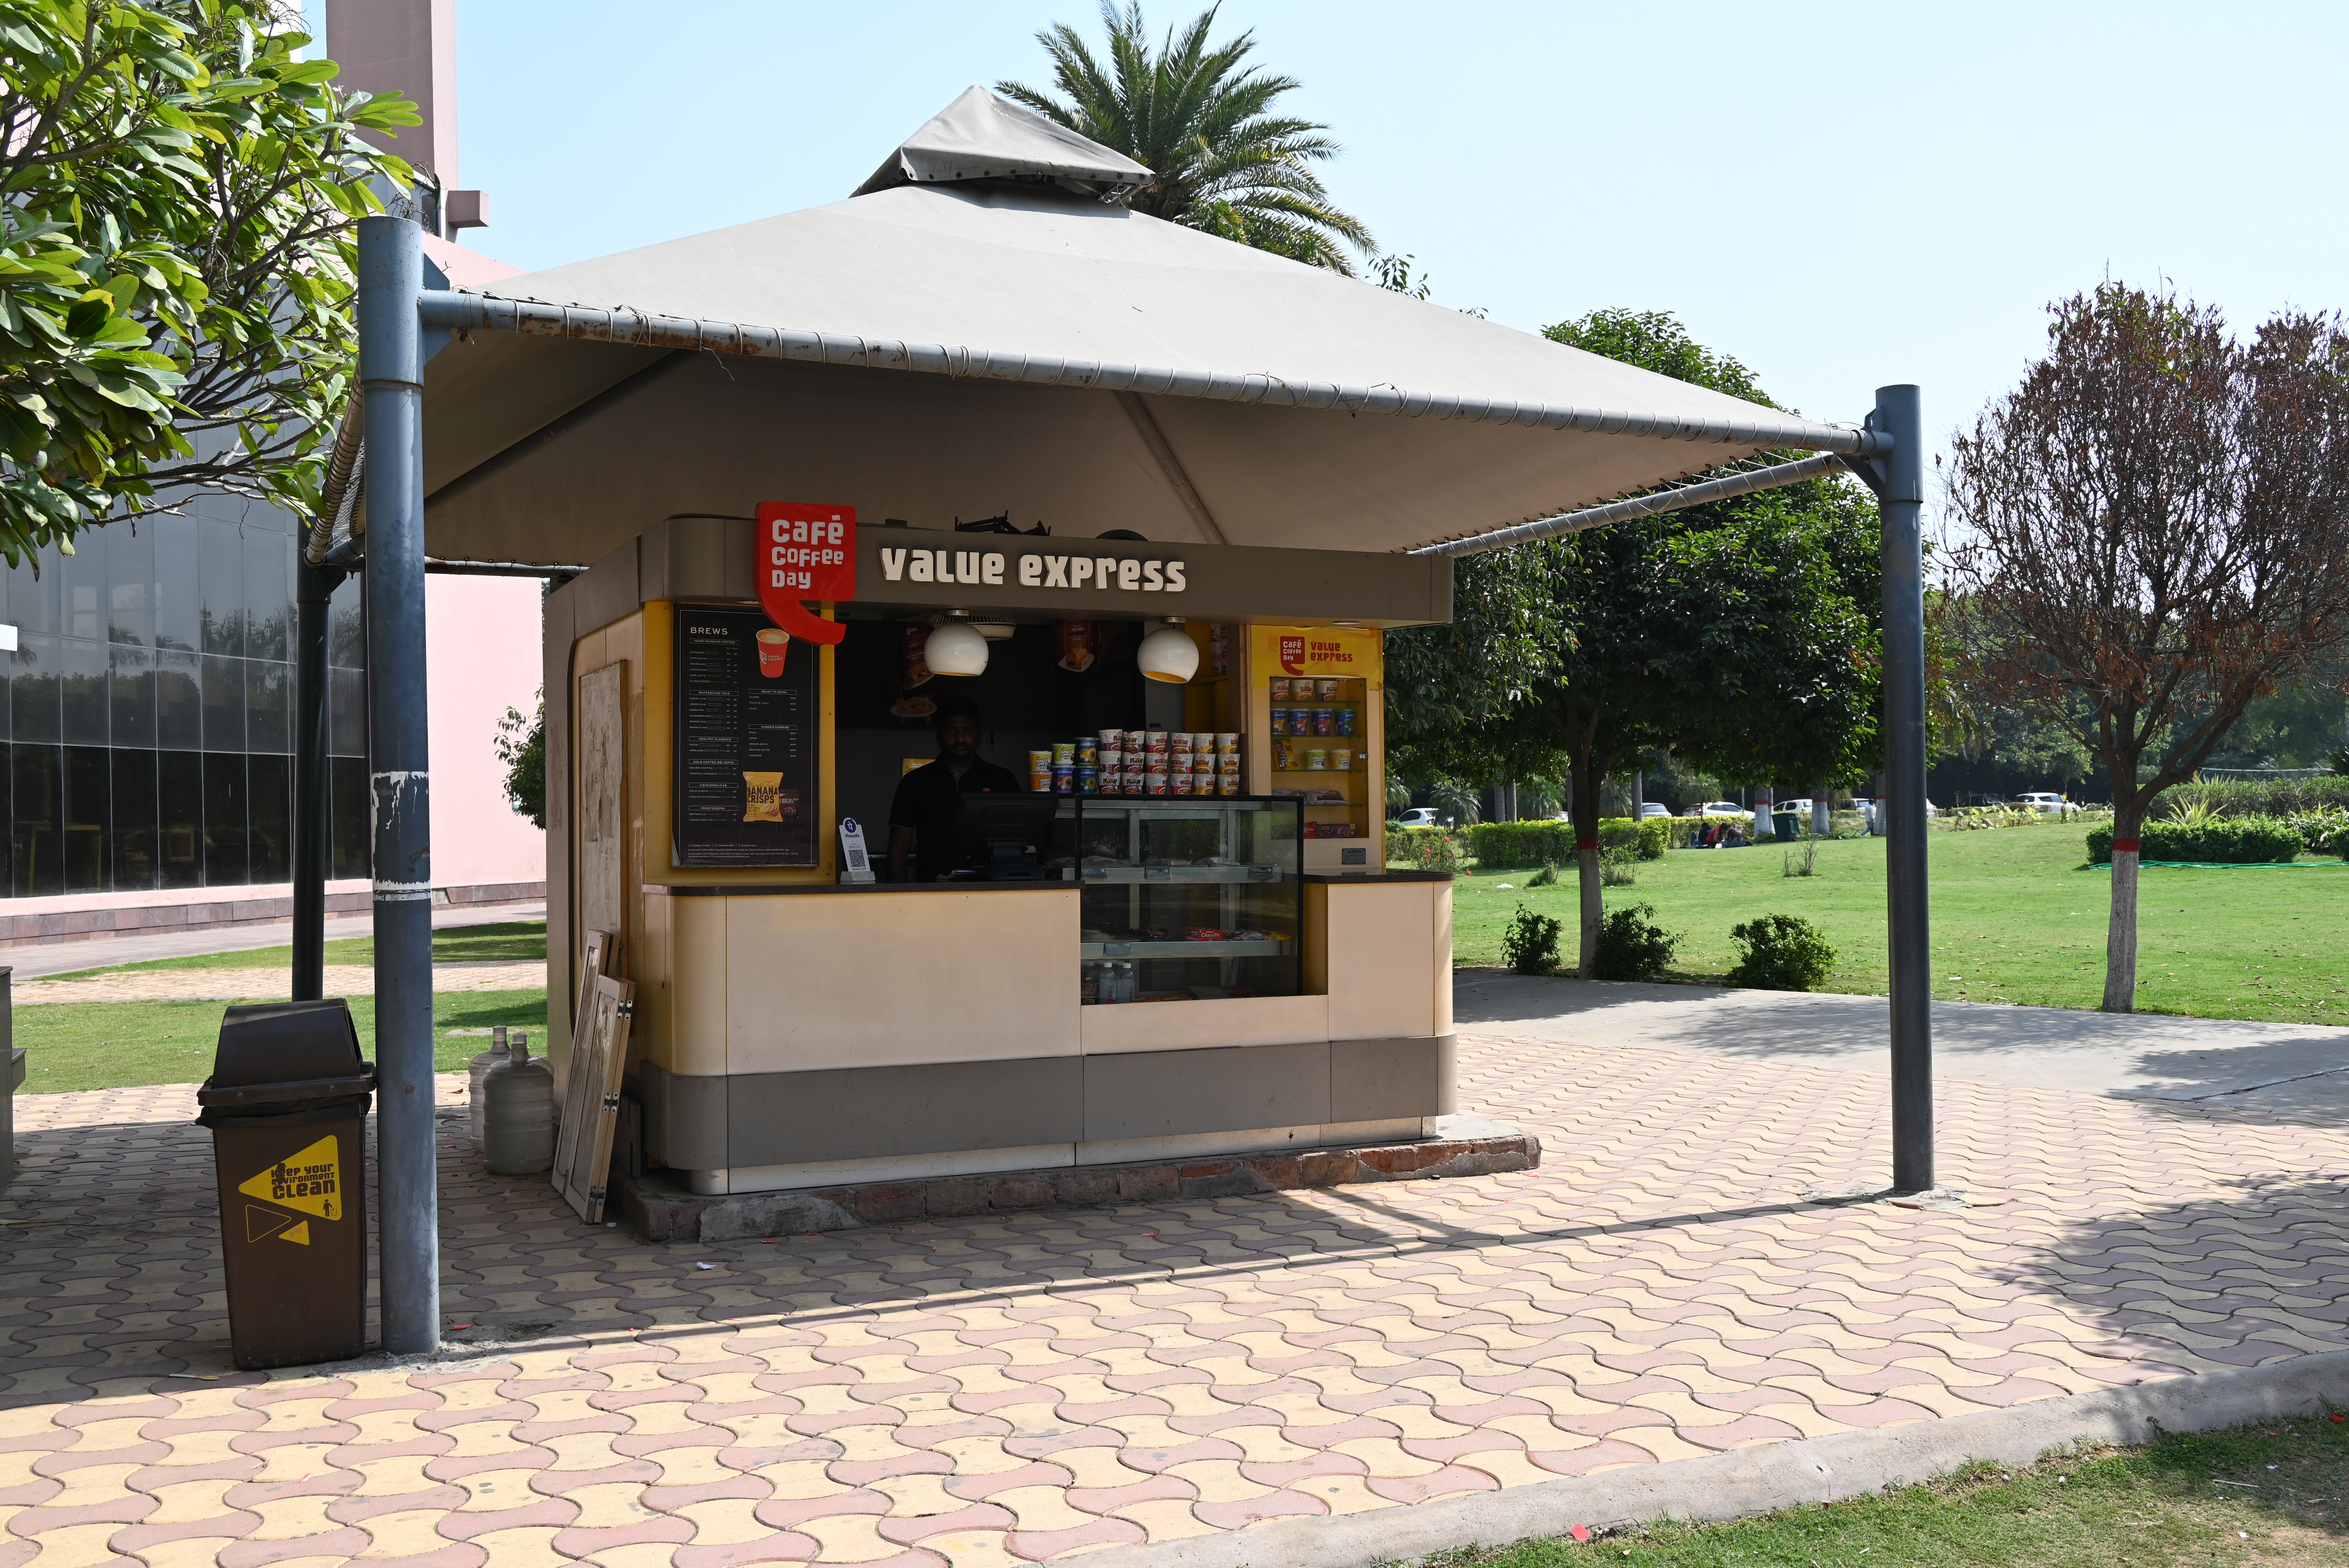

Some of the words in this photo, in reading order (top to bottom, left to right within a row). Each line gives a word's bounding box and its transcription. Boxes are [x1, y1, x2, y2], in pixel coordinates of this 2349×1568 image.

[772, 570, 811, 589] Day
[747, 787, 778, 795] BANANA
[747, 795, 774, 803] CRISPS
[304, 1164, 333, 1174] your
